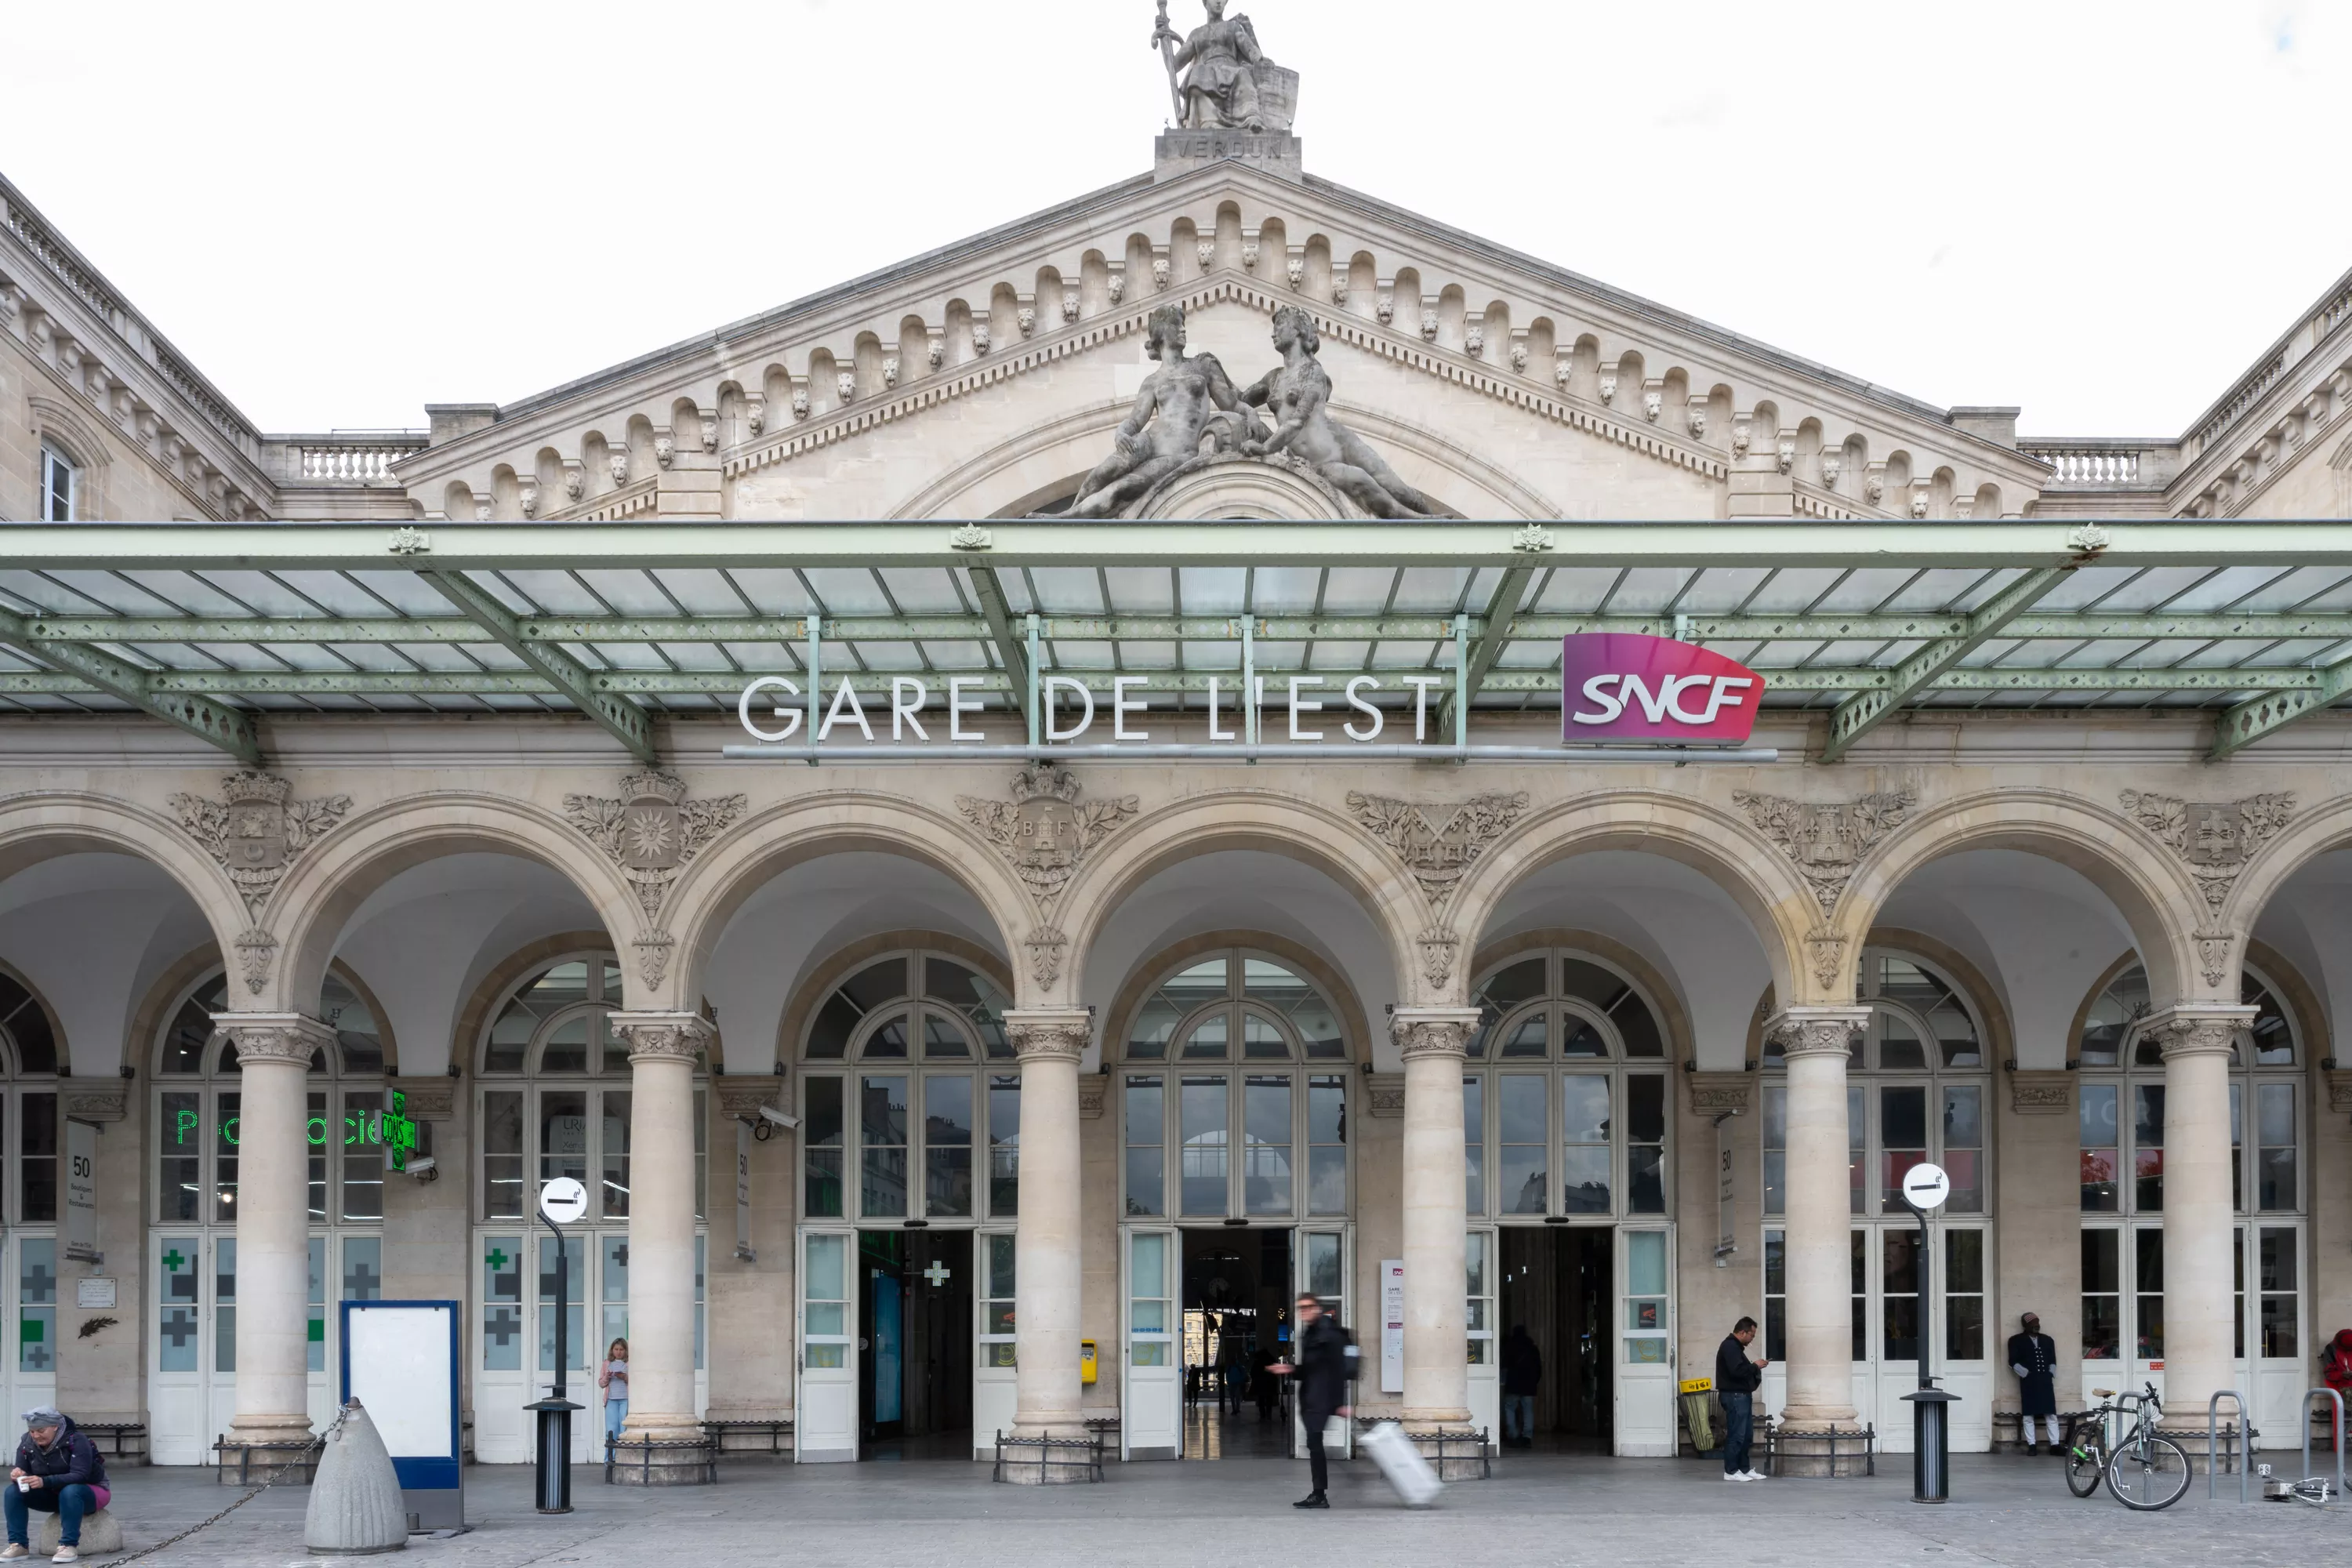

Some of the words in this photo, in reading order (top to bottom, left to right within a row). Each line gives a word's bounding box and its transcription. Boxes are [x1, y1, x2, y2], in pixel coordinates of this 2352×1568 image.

[1175, 140, 1282, 158] VERDUN
[1573, 674, 1752, 724] SNCF
[739, 675, 984, 742] GARE
[1045, 676, 1149, 740] DE
[1209, 675, 1441, 742] L'EST
[1023, 821, 1033, 836] B
[1057, 820, 1068, 836] F
[233, 869, 278, 882] VESOUL
[635, 871, 670, 882] LURE
[74, 1155, 90, 1178] 50
[740, 1153, 747, 1176] 50
[1723, 1149, 1731, 1171] 50
[71, 1182, 93, 1193] Boutiques
[69, 1198, 94, 1209] Restaurants
